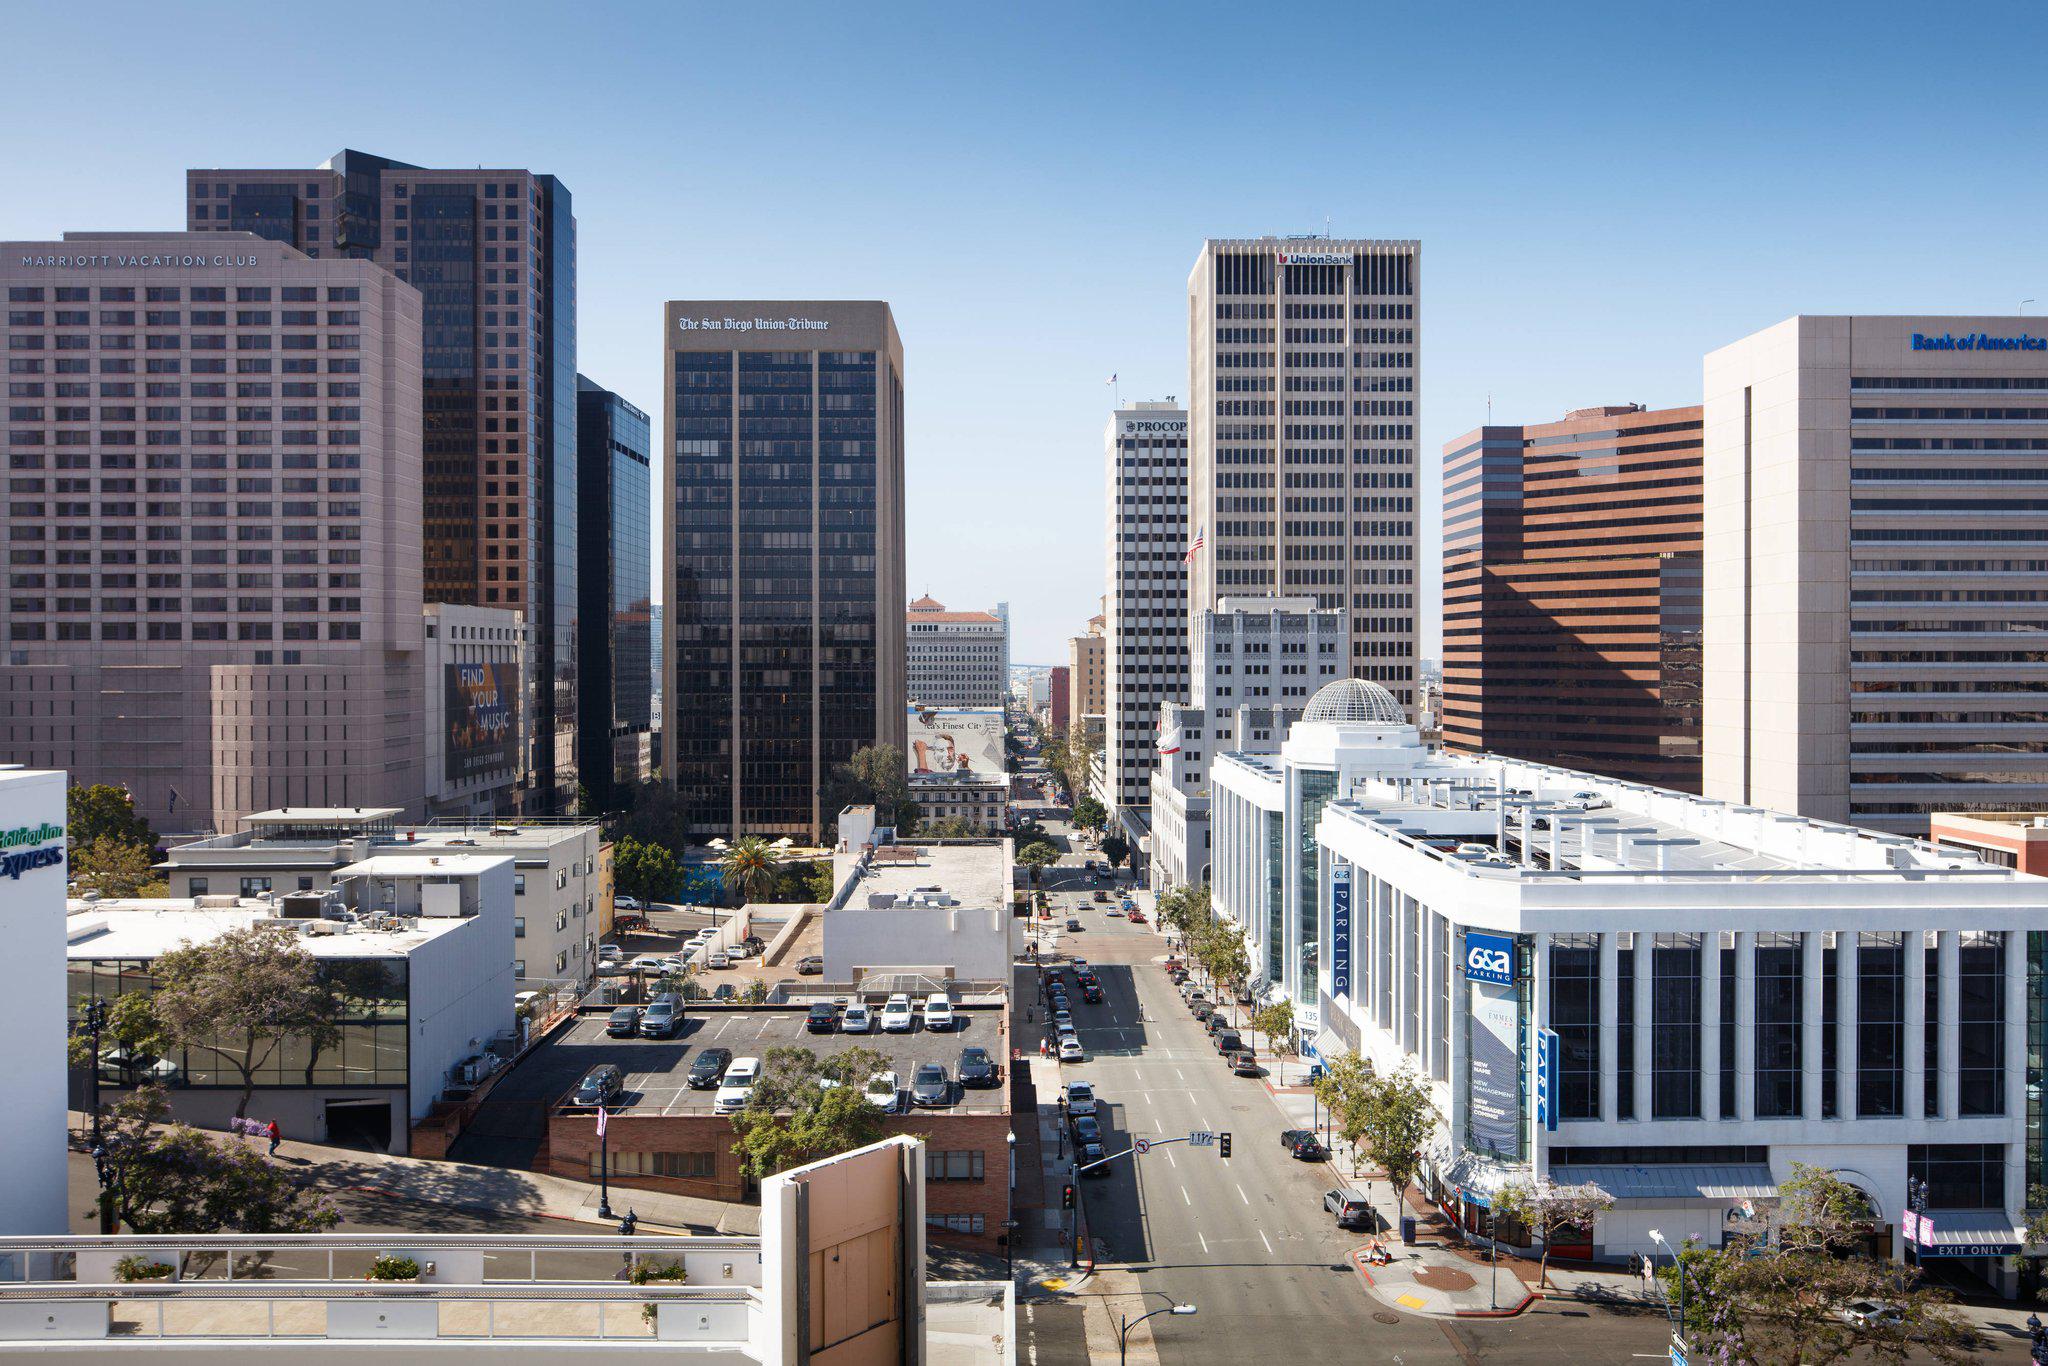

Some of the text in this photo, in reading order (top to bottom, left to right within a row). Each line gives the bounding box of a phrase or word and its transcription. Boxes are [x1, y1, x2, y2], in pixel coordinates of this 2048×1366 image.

[21, 255, 258, 267] MARRIOTT VACATION CLUB
[1290, 254, 1352, 265] UnionBank
[679, 317, 829, 333] The San Diego Union-Tribune
[1911, 333, 2047, 351] Bank of America
[461, 668, 486, 688] FIND
[471, 690, 499, 709] YOUR
[480, 711, 510, 731] MUSIC
[942, 722, 965, 730] Finest
[1335, 890, 1348, 988] PARKING
[1468, 946, 1510, 974] 6&a
[1467, 968, 1511, 982] PARKING
[1305, 1011, 1318, 1021] 135
[1538, 1037, 1546, 1109] PARK
[1473, 1085, 1515, 1099] MANAGEMENT
[1939, 1245, 2003, 1256] EXIT ONLY
